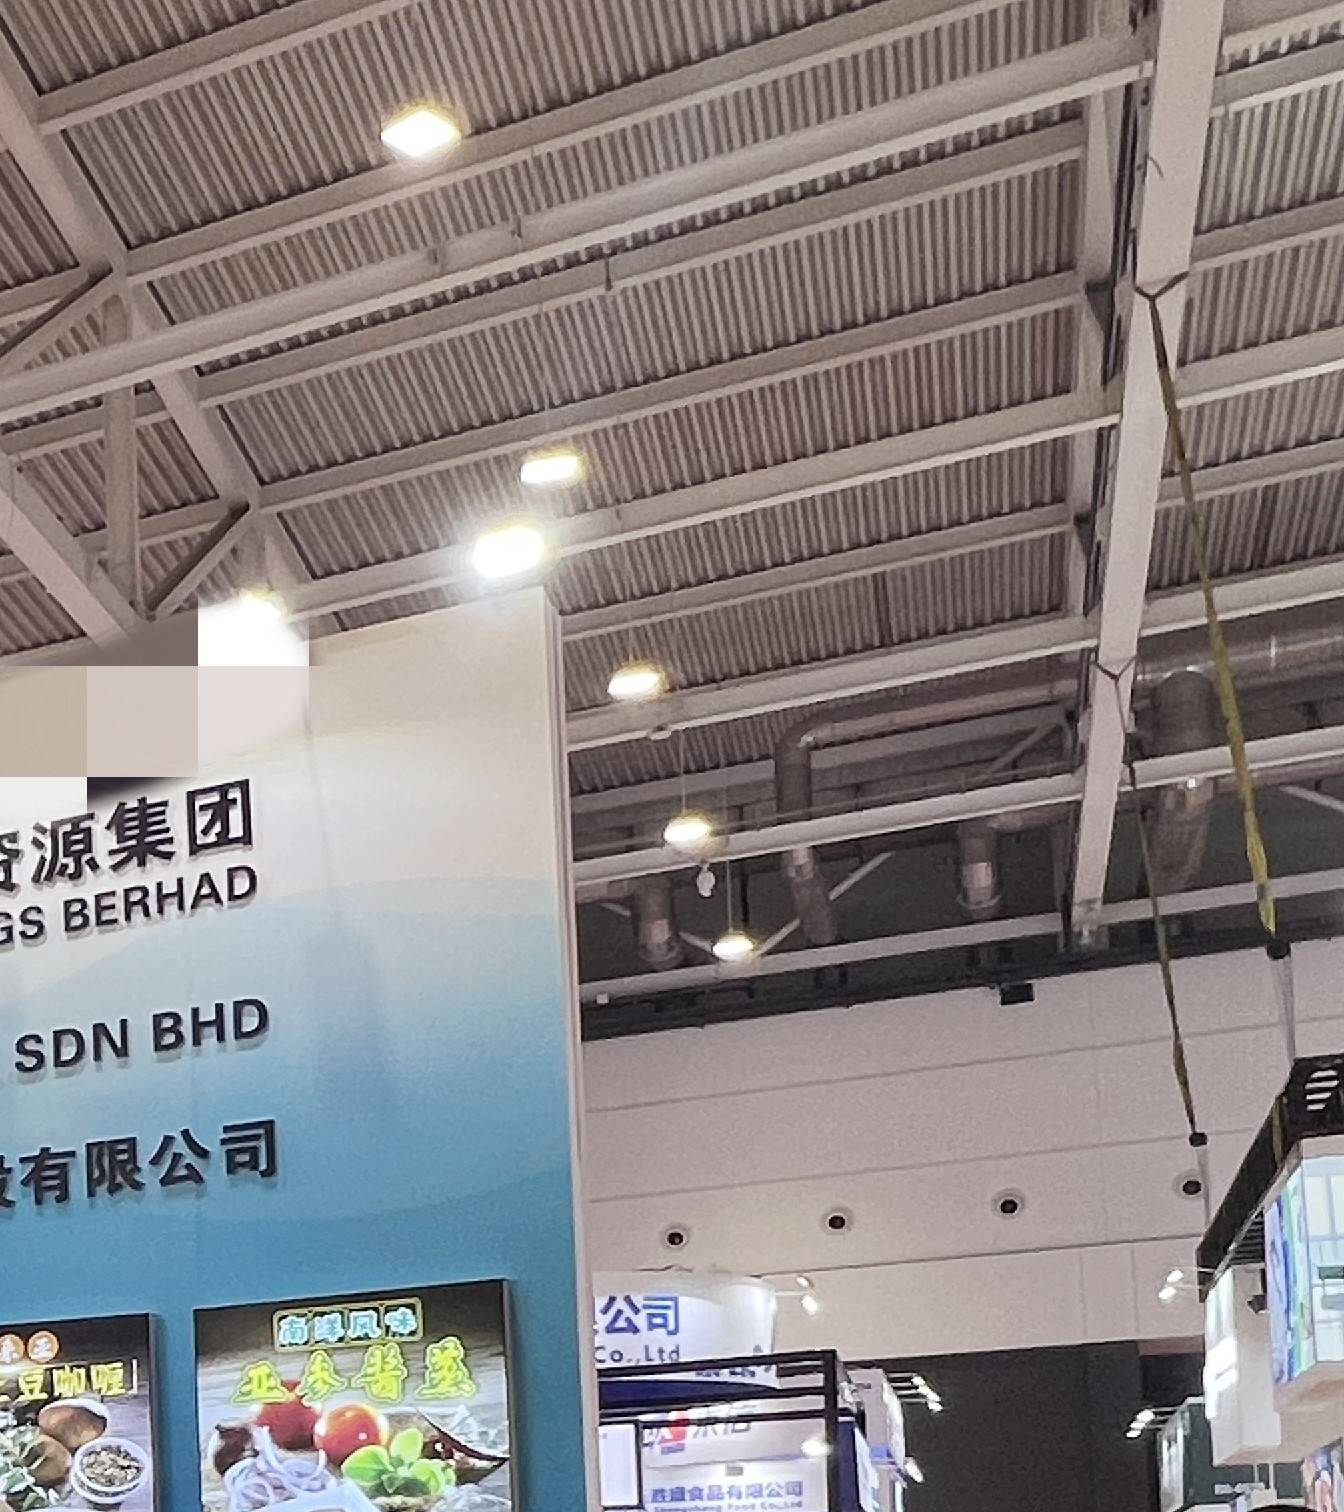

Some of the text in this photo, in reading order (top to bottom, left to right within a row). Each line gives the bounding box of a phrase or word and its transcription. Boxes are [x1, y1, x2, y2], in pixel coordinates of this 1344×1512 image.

[63, 865, 259, 934] BERHAD
[14, 1018, 129, 1074] SDN
[152, 998, 270, 1053] BHD
[595, 1294, 680, 1336] 公司
